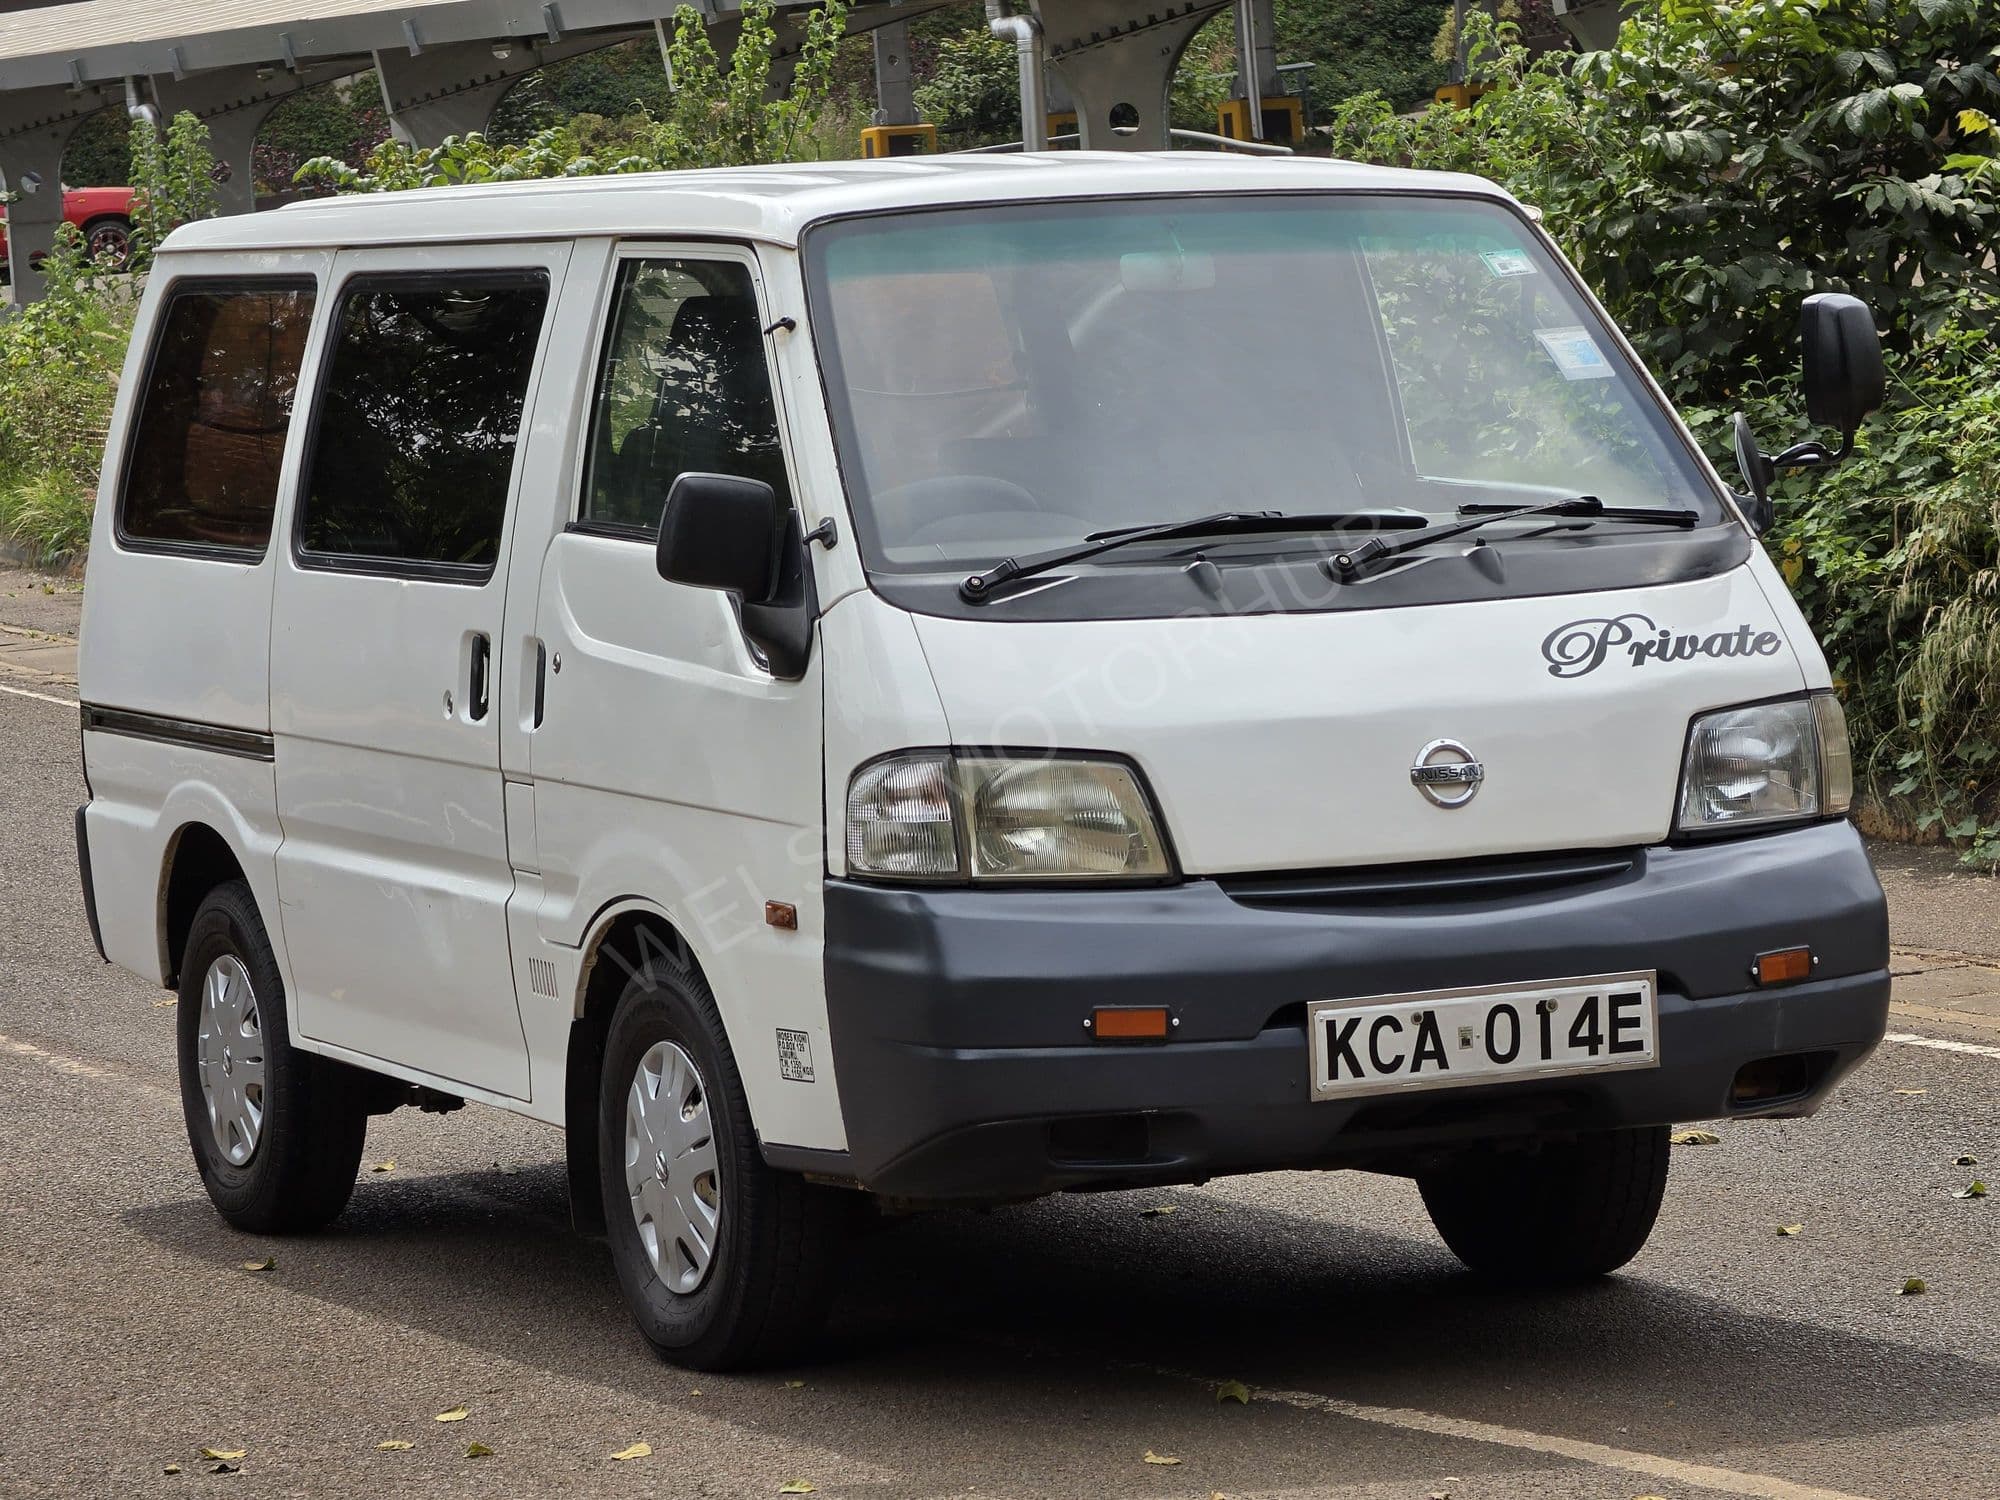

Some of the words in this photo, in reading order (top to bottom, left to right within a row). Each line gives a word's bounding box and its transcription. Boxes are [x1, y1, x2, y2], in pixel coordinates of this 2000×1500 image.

[1541, 613, 1781, 678] Private
[1421, 764, 1479, 780] NISSAN
[1325, 1010, 1450, 1080] KCA
[1485, 991, 1644, 1064] 014E
